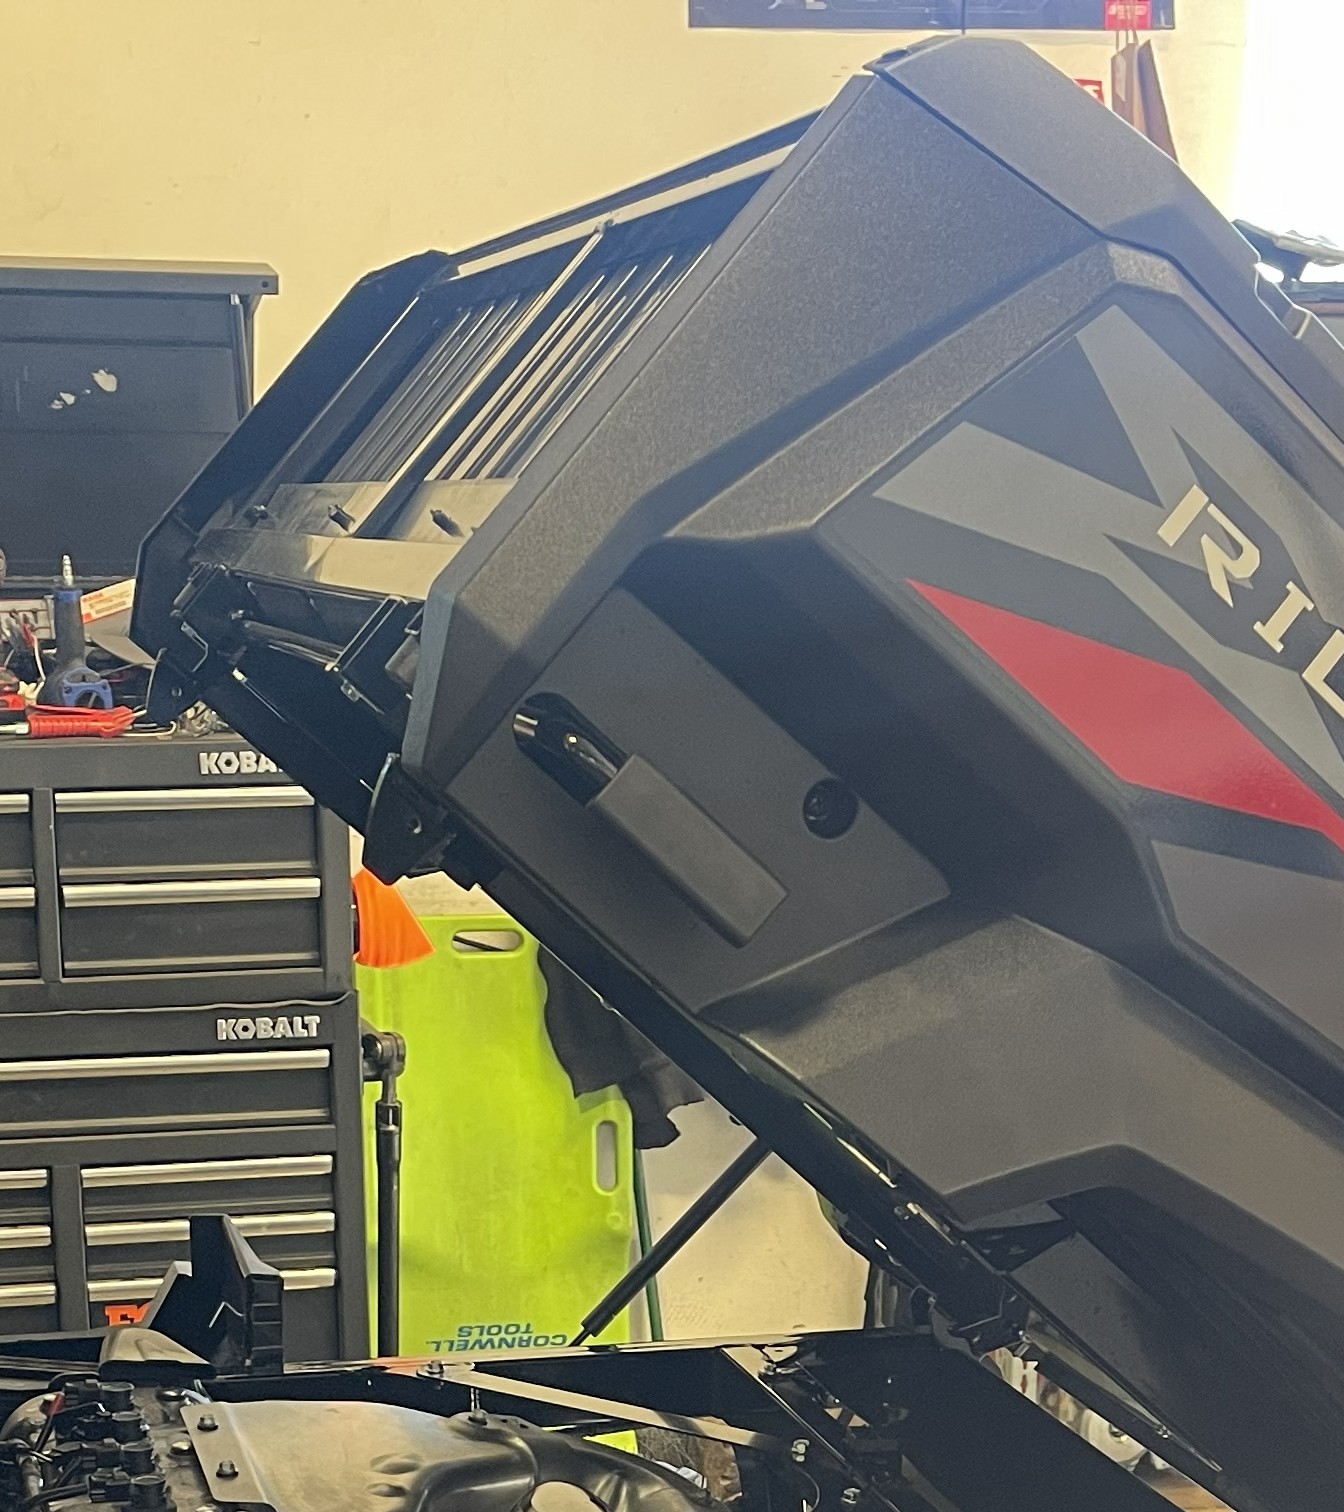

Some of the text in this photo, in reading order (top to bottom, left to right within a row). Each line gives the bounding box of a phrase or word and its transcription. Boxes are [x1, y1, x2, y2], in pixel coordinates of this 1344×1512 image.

[198, 750, 284, 775] KOBA
[216, 1015, 321, 1041] KOBALT
[457, 1322, 534, 1338] TOOLS
[429, 1334, 568, 1352] CORNWELL
